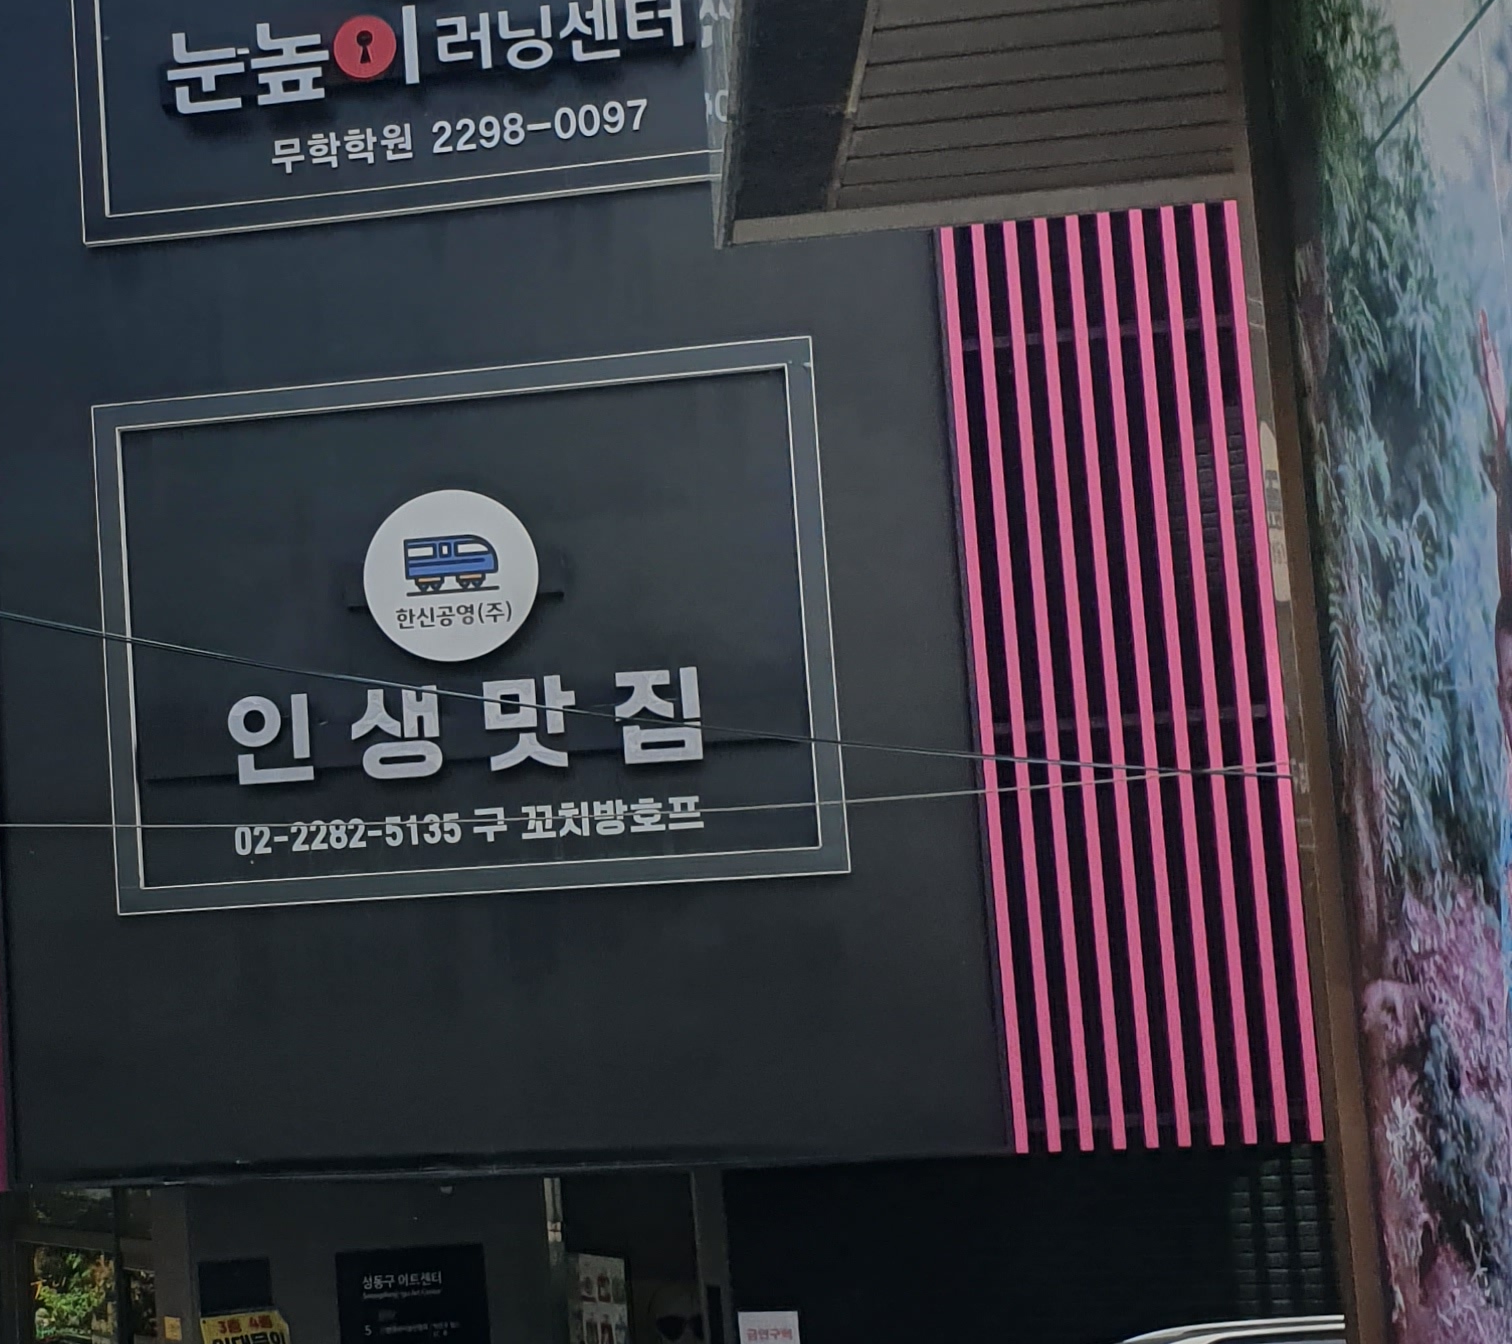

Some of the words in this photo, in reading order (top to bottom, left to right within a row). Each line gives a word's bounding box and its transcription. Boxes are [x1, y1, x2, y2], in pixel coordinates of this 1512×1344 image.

[165, 5, 420, 117] 눈높이
[270, 123, 414, 175] 무학학원
[431, 97, 650, 158] 2298-0097
[394, 598, 514, 632] 한신공영(주)
[233, 812, 463, 858] 02-2282-5135
[472, 806, 509, 844] 구
[362, 1274, 396, 1290] 성동구
[364, 1324, 373, 1336] 5
